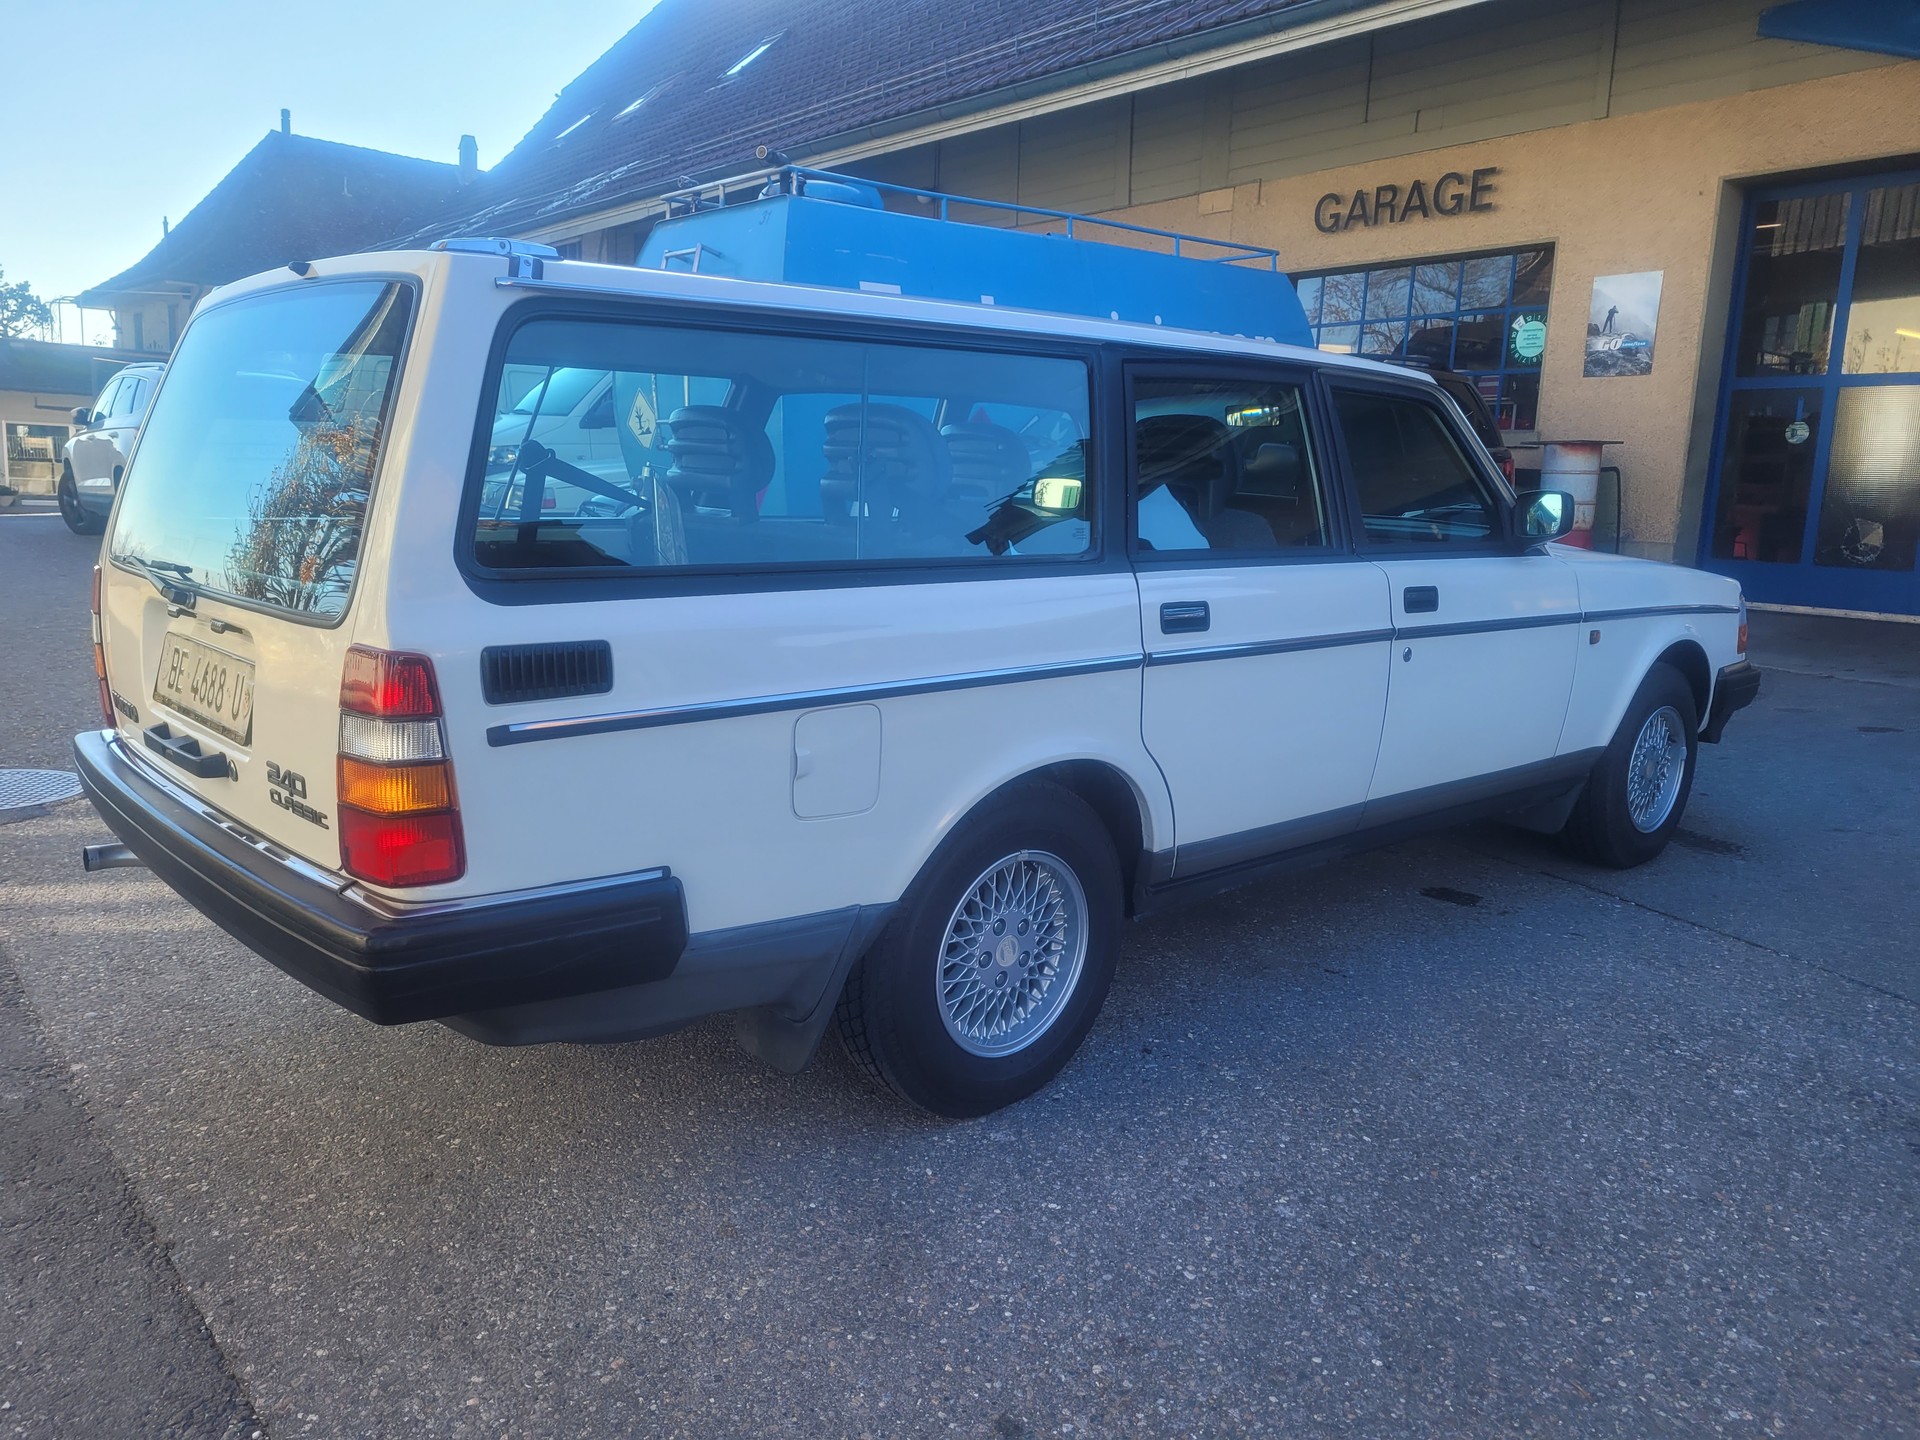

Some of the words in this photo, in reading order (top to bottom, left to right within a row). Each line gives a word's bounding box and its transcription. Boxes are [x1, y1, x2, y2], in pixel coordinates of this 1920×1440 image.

[1314, 166, 1498, 233] GARAGE
[167, 646, 190, 694] BE
[190, 656, 227, 713] 4688
[231, 672, 246, 722] U
[265, 760, 308, 800] 240
[269, 788, 330, 830] CLASSIC
